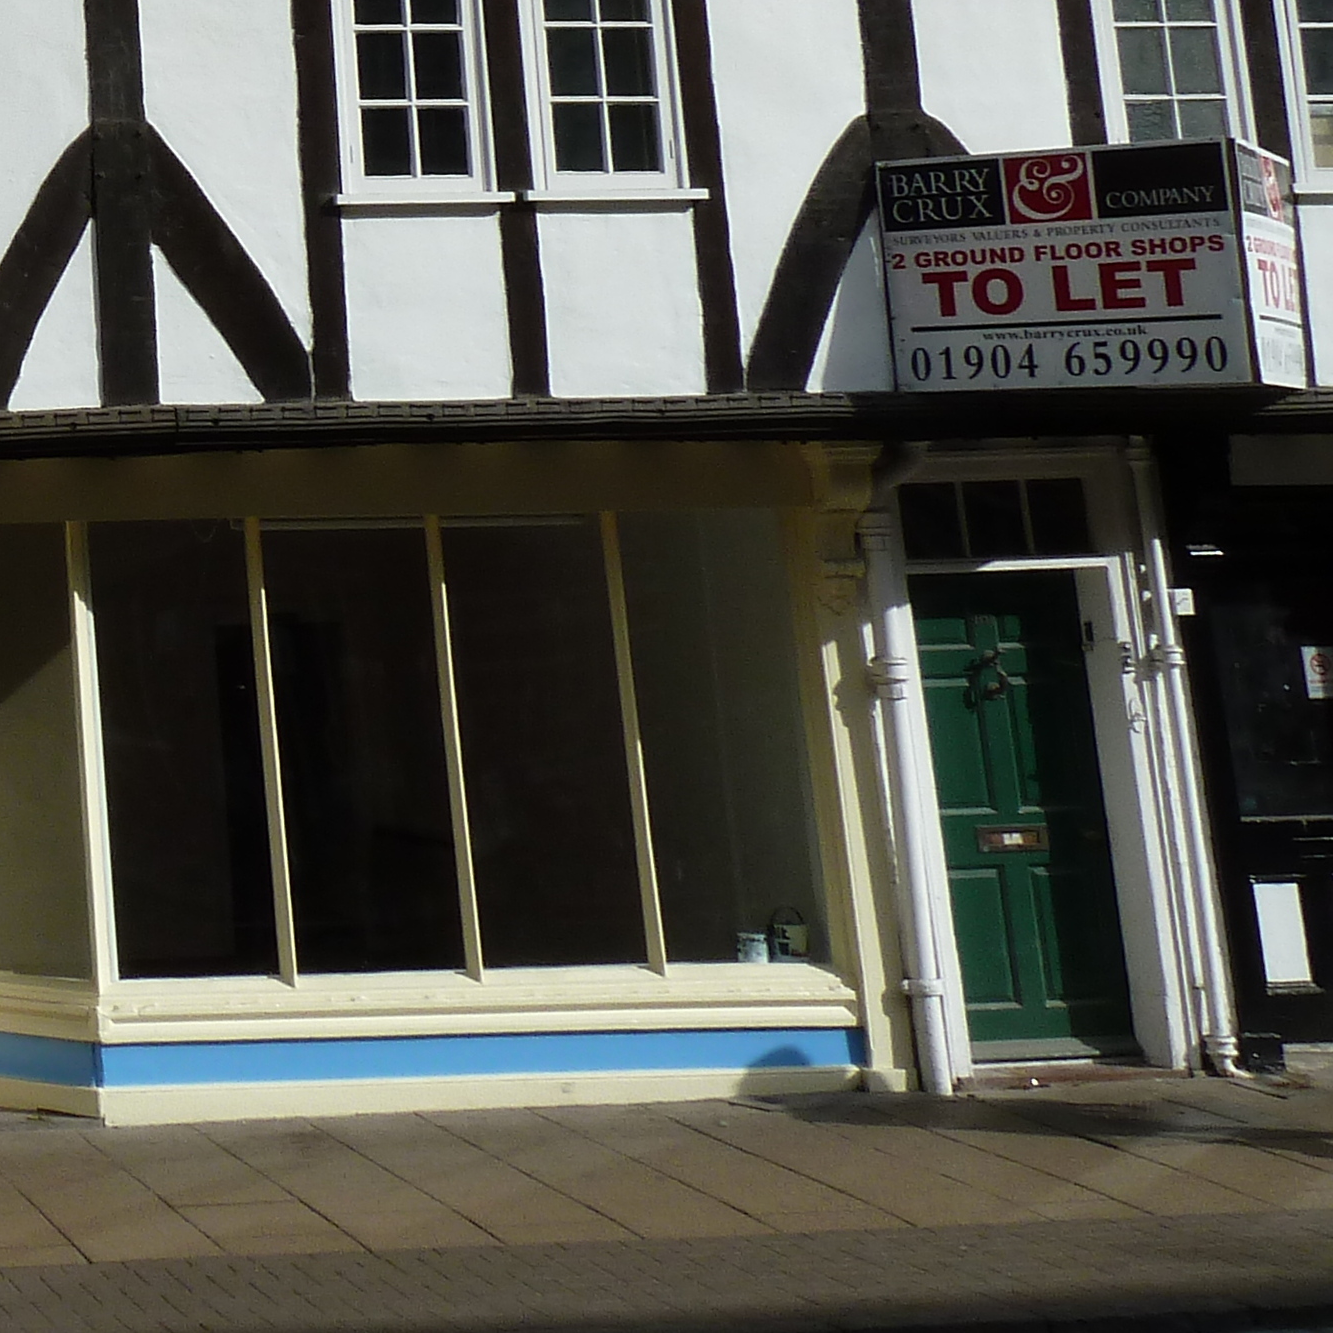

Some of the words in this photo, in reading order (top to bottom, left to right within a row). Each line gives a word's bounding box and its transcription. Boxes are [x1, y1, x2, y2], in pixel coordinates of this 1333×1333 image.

[888, 168, 990, 198] BARRY
[1012, 154, 1085, 221] &
[1104, 185, 1215, 209] COMPANY
[892, 194, 994, 224] CRUX
[891, 231, 967, 247] SURVEYORS
[972, 228, 1029, 243] VALUERS
[1033, 228, 1042, 239] &
[1046, 222, 1116, 238] PROPERTY
[1120, 216, 1222, 234] CONSULTANTS
[891, 253, 907, 269] 2
[914, 245, 1025, 268] GROUND
[1034, 240, 1123, 262] FLOOR
[1131, 234, 1226, 256] SHOPS
[921, 267, 1025, 317] TO
[1052, 257, 1197, 312] LET
[1257, 258, 1280, 309] TO
[982, 324, 1149, 342] www.barrycrux.co.uk
[911, 343, 1039, 382] 01904
[1065, 335, 1228, 378] 659990
